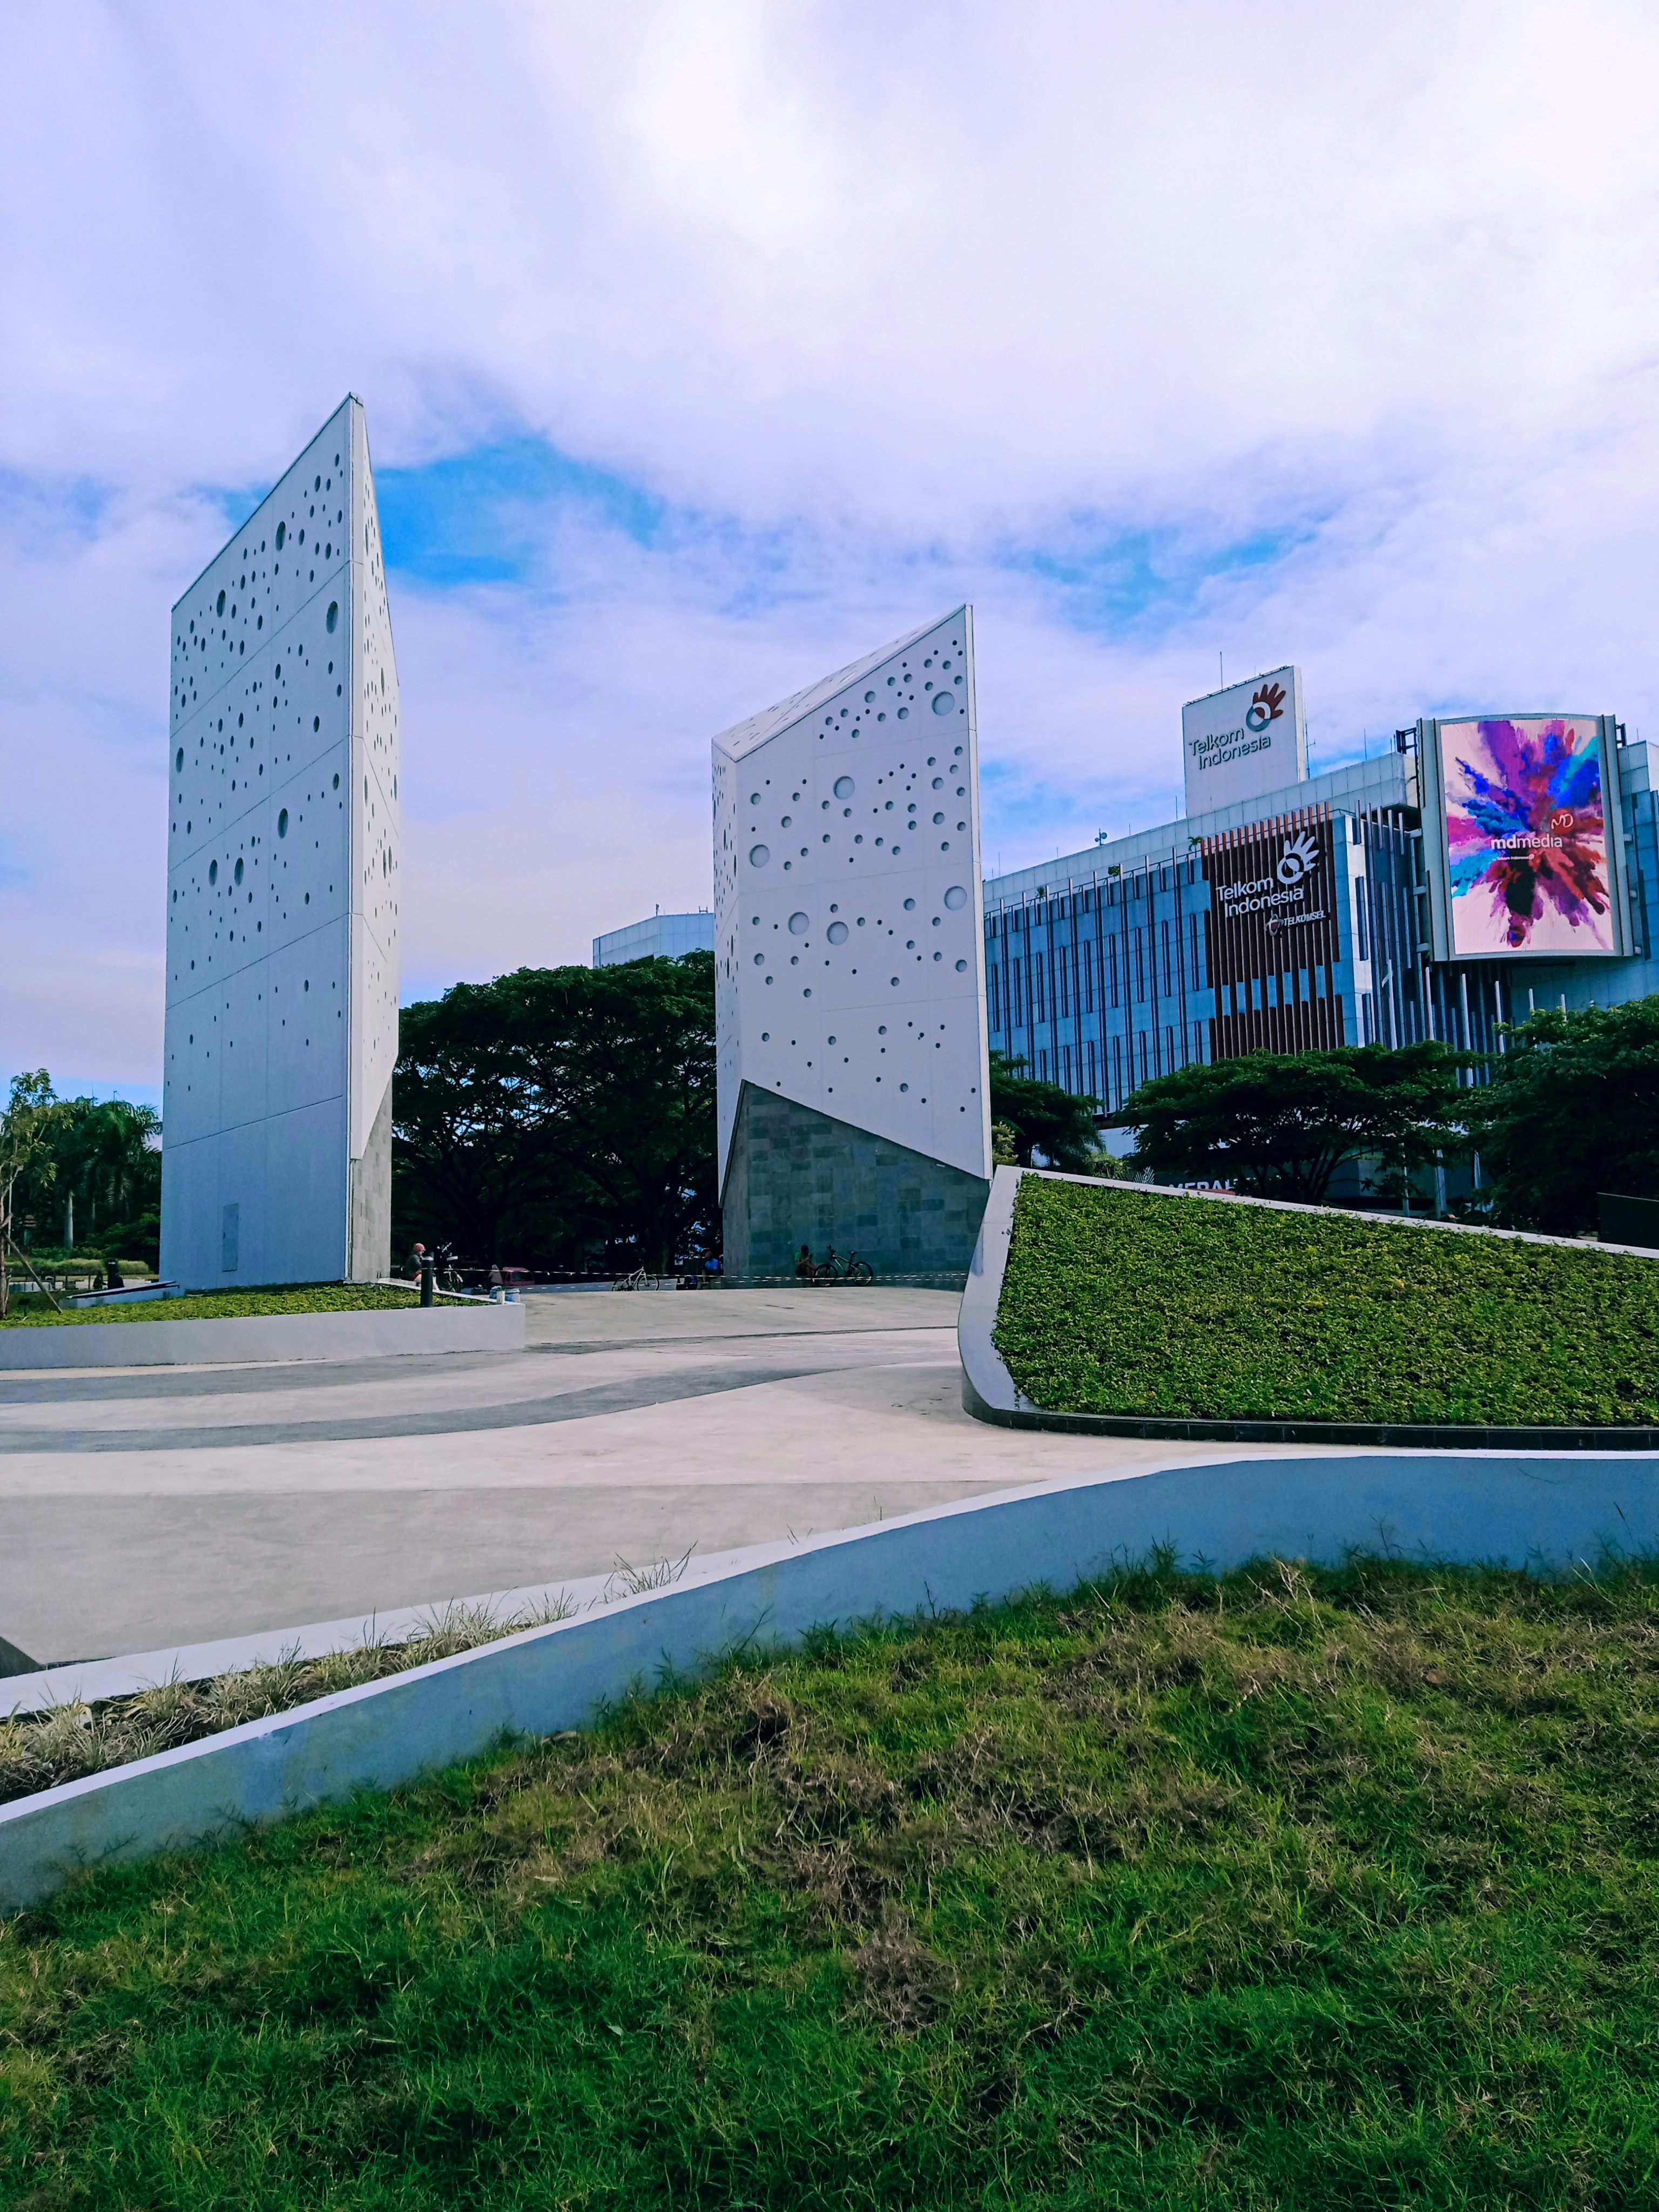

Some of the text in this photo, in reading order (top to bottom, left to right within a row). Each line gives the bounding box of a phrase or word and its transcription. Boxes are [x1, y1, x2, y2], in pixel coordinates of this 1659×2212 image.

[1189, 728, 1244, 756] Telkom
[1198, 736, 1271, 770] Indonesia
[1492, 833, 1562, 849] mdmedia
[1216, 878, 1273, 901] Telkom
[1225, 888, 1304, 918] Indonesia
[1284, 911, 1326, 926] TELKOMSEL
